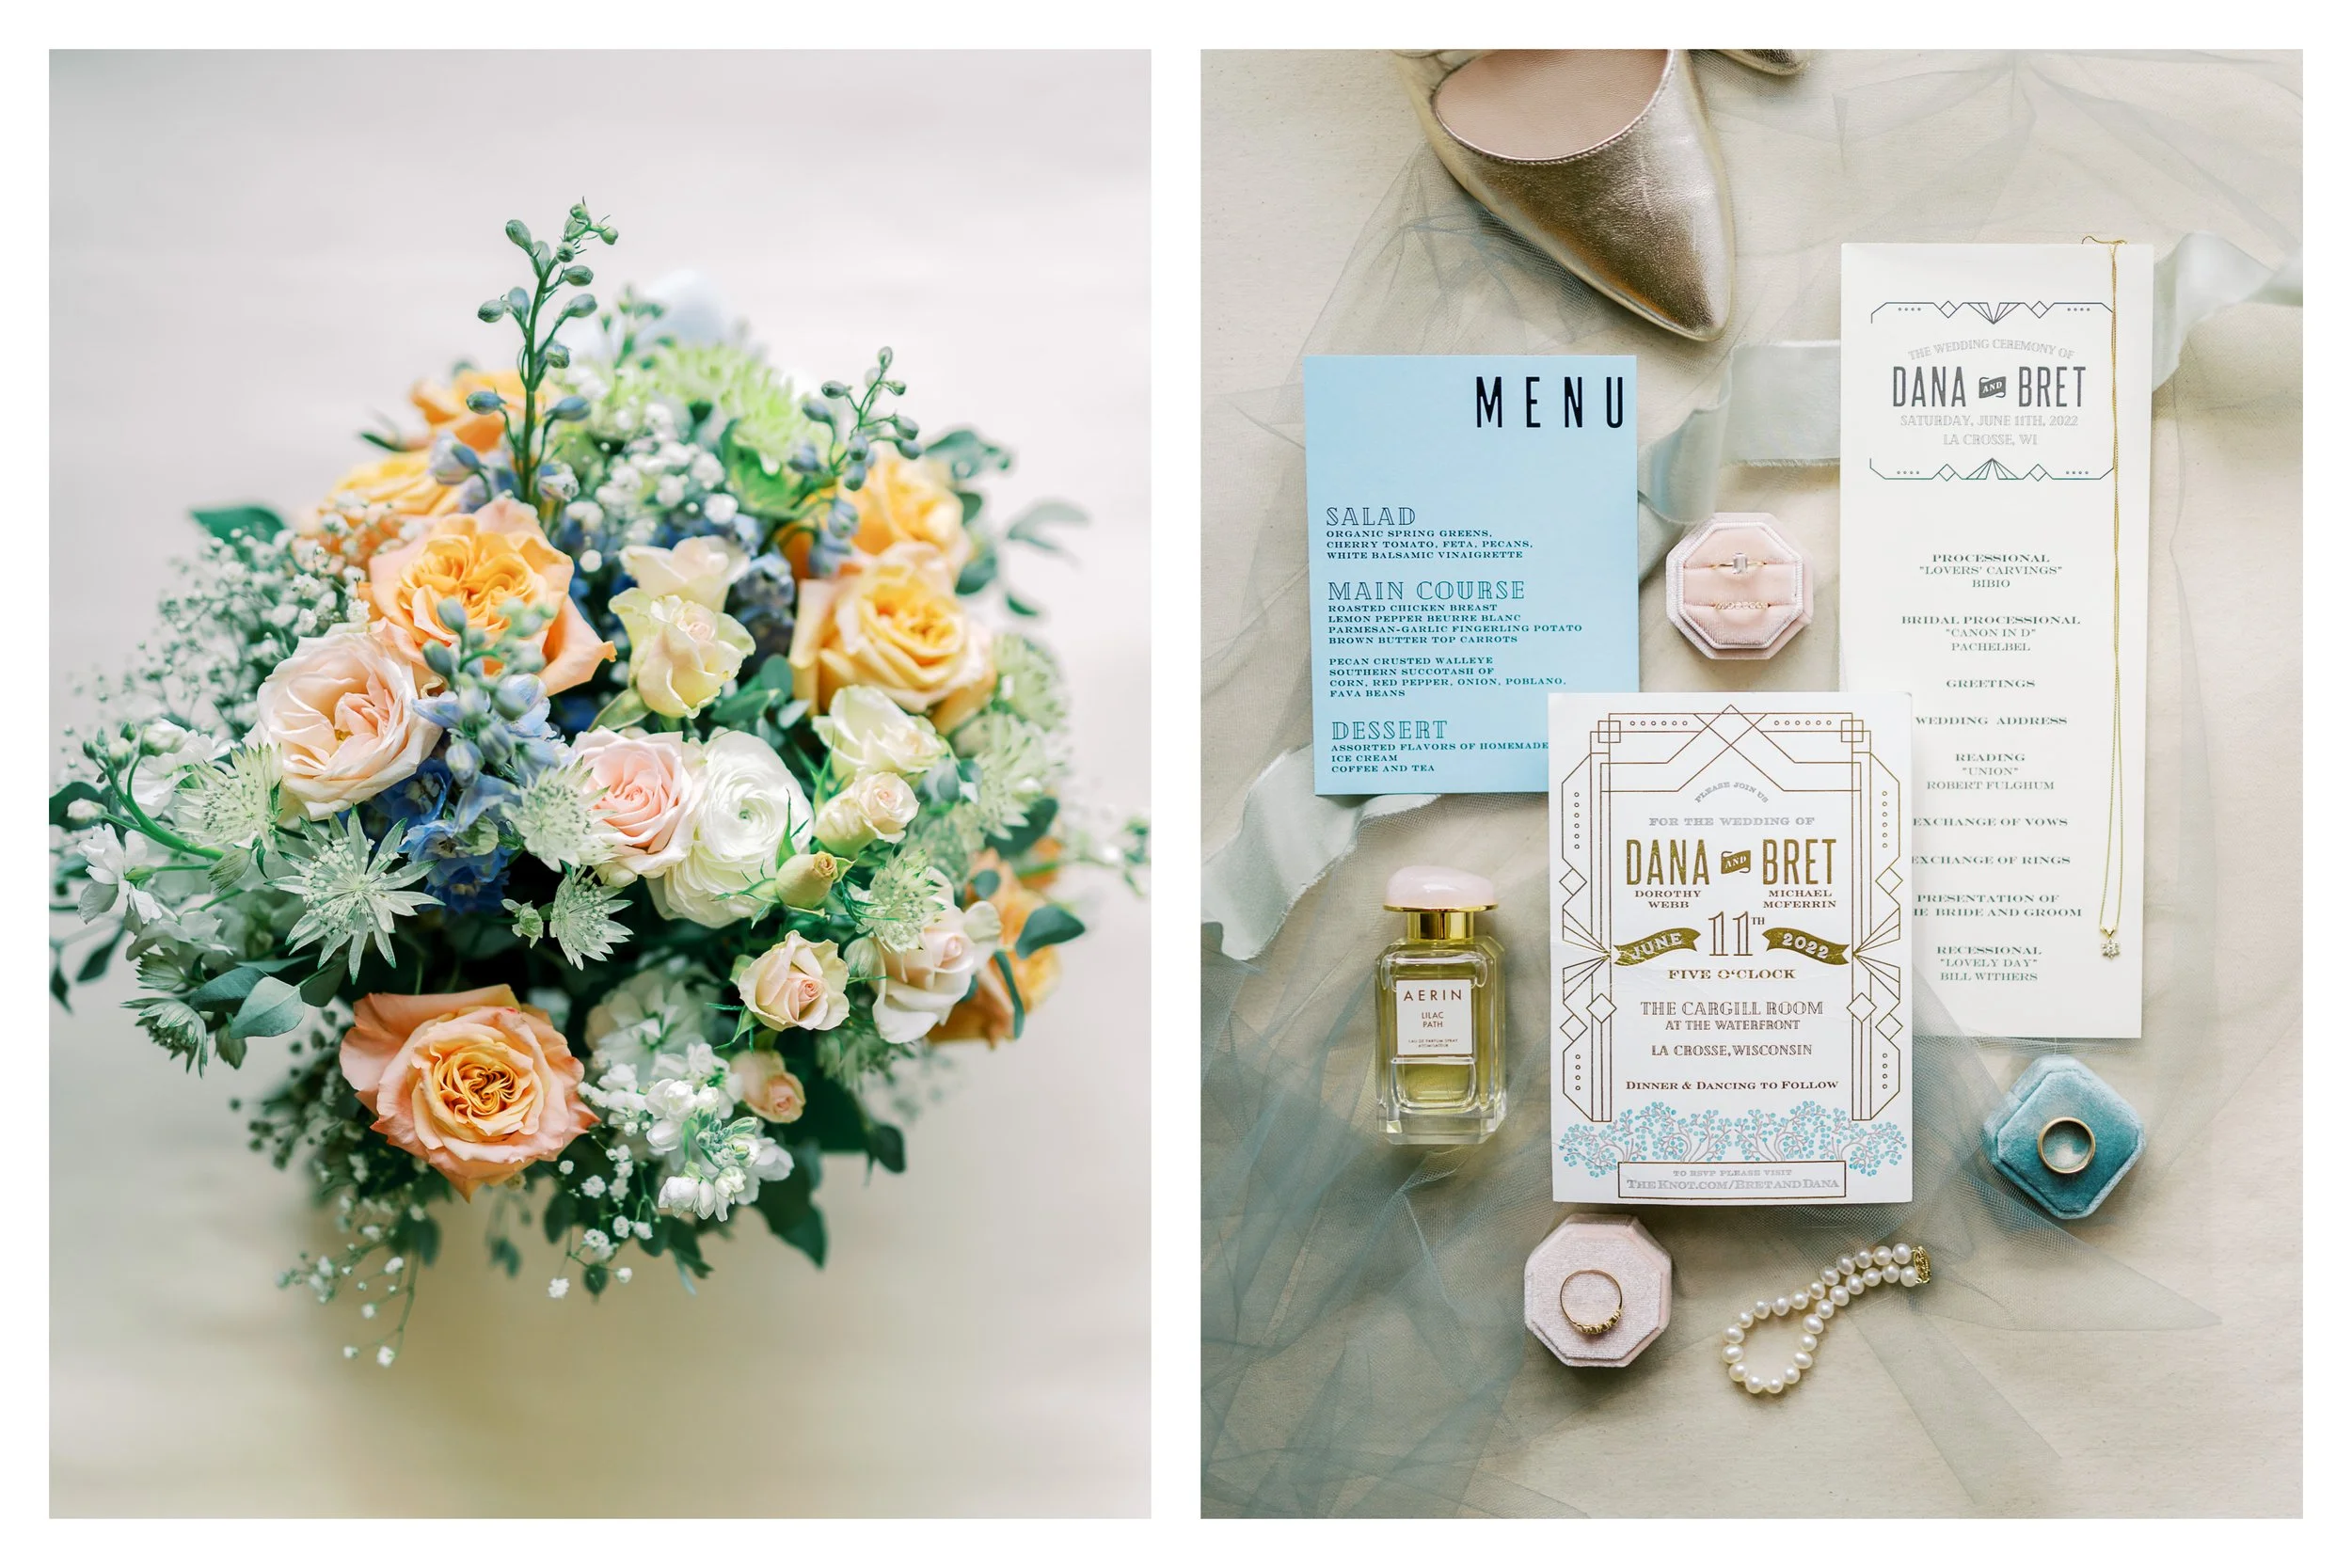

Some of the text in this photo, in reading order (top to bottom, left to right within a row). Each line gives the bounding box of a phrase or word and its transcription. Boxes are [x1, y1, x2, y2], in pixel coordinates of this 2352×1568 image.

[1908, 340, 2075, 359] THE WEDDING CEREMONY OF
[1893, 366, 2086, 407] DANA AND BRET
[1476, 376, 1623, 428] MENU
[1900, 414, 2078, 428] SATURDAY, JUNE 11TH, 2022
[1944, 434, 2037, 446] LA CROSSE, WI
[1327, 507, 1415, 526] SALAD
[1327, 530, 1491, 538] ORGANIC SPRING GREENS,
[1327, 540, 1533, 549] CHERRY TOMATO, FETA, PECANS,
[1327, 550, 1522, 560] WHITE BALSAMIC VINAIGRETTE
[1933, 554, 2049, 562] PROCESSIONAL
[1920, 566, 2062, 575] "LOVERS' CARVINGS"
[1973, 578, 2010, 588] BIBIO
[1328, 581, 1524, 600] MAIN COURSE
[1328, 603, 1497, 612] ROASTED CHICKEN BREAST
[1328, 615, 1371, 624] LEMON
[1375, 614, 1422, 623] PEPPER
[1427, 614, 1477, 623] BEURRE
[1902, 615, 2080, 625] BRIDAL PROCESSIONAL
[1328, 624, 1581, 634] PARMESAN-GARLIC FINGERLING POTATO
[1947, 628, 2036, 638] "CANON IN D"
[1378, 636, 1426, 644] BUTTER
[1432, 636, 1455, 644] TOP
[1460, 635, 1518, 643] CARROTS
[1952, 642, 2030, 652] PACHELBEL
[1329, 657, 1492, 666] PECAN CRUSTED WALLEYE
[1329, 667, 1494, 676] SOUTHERN SUCCOTASH OF
[1330, 677, 1565, 688] CORN, RED PEPPER, ONION, POBLANO,
[1947, 679, 2035, 689] GREETINGS
[1330, 689, 1405, 698] FAVA BEANS
[1916, 716, 2067, 725] WEDDING ADDRESS
[1332, 721, 1447, 740] DESSERT
[1331, 741, 1549, 752] ASSORTED FLAVORS OF HOMEMADE
[1332, 753, 1397, 763] ICE CREAM
[1957, 753, 2025, 762] READING
[1332, 764, 1434, 773] COFFEE AND TEA
[1963, 767, 2018, 776] "UNION"
[1927, 781, 2054, 790] ROBERT FULGHUM
[1694, 782, 1769, 802] PLEASE JOIN US
[1649, 816, 1815, 827] FOR THE WEDDING OF
[1913, 817, 2067, 827] EXCHANGE OF VOWS
[1627, 839, 1836, 885] DANA AND BRET
[1912, 856, 2070, 864] EXCHANGE OF RINGS
[1635, 890, 1701, 898] DOROTHY
[1769, 889, 1832, 897] MICHAEL
[1917, 894, 2058, 903] PRESENTATION OF
[1648, 900, 1689, 909] WEBB
[1763, 900, 1836, 909] MCFERRIN
[1936, 908, 1983, 917] BRIDE
[1988, 908, 2019, 917] AND
[2024, 908, 2081, 917] GROOM
[1630, 932, 1684, 960] JUNE
[1783, 932, 1830, 959] 2022
[1937, 945, 2042, 955] RECESSIONAL
[1941, 958, 2037, 968] "LOVELY DAY"
[1668, 970, 1710, 979] FIVE
[1941, 972, 2038, 981] BILL WITHERS
[1404, 990, 1461, 1001] AERIN
[1641, 1002, 1822, 1015] THE CARGILL ROOM
[1422, 1010, 1444, 1020] LILAC
[1422, 1021, 1443, 1029] PATH
[1665, 1020, 1801, 1030] AT THE WATERFRONT
[1652, 1045, 1669, 1055] LA
[1682, 1081, 1692, 1090] &
[1673, 1169, 1687, 1178] TO
[1690, 1169, 1716, 1178] RSVP
[1763, 1168, 1792, 1177] VISIT
